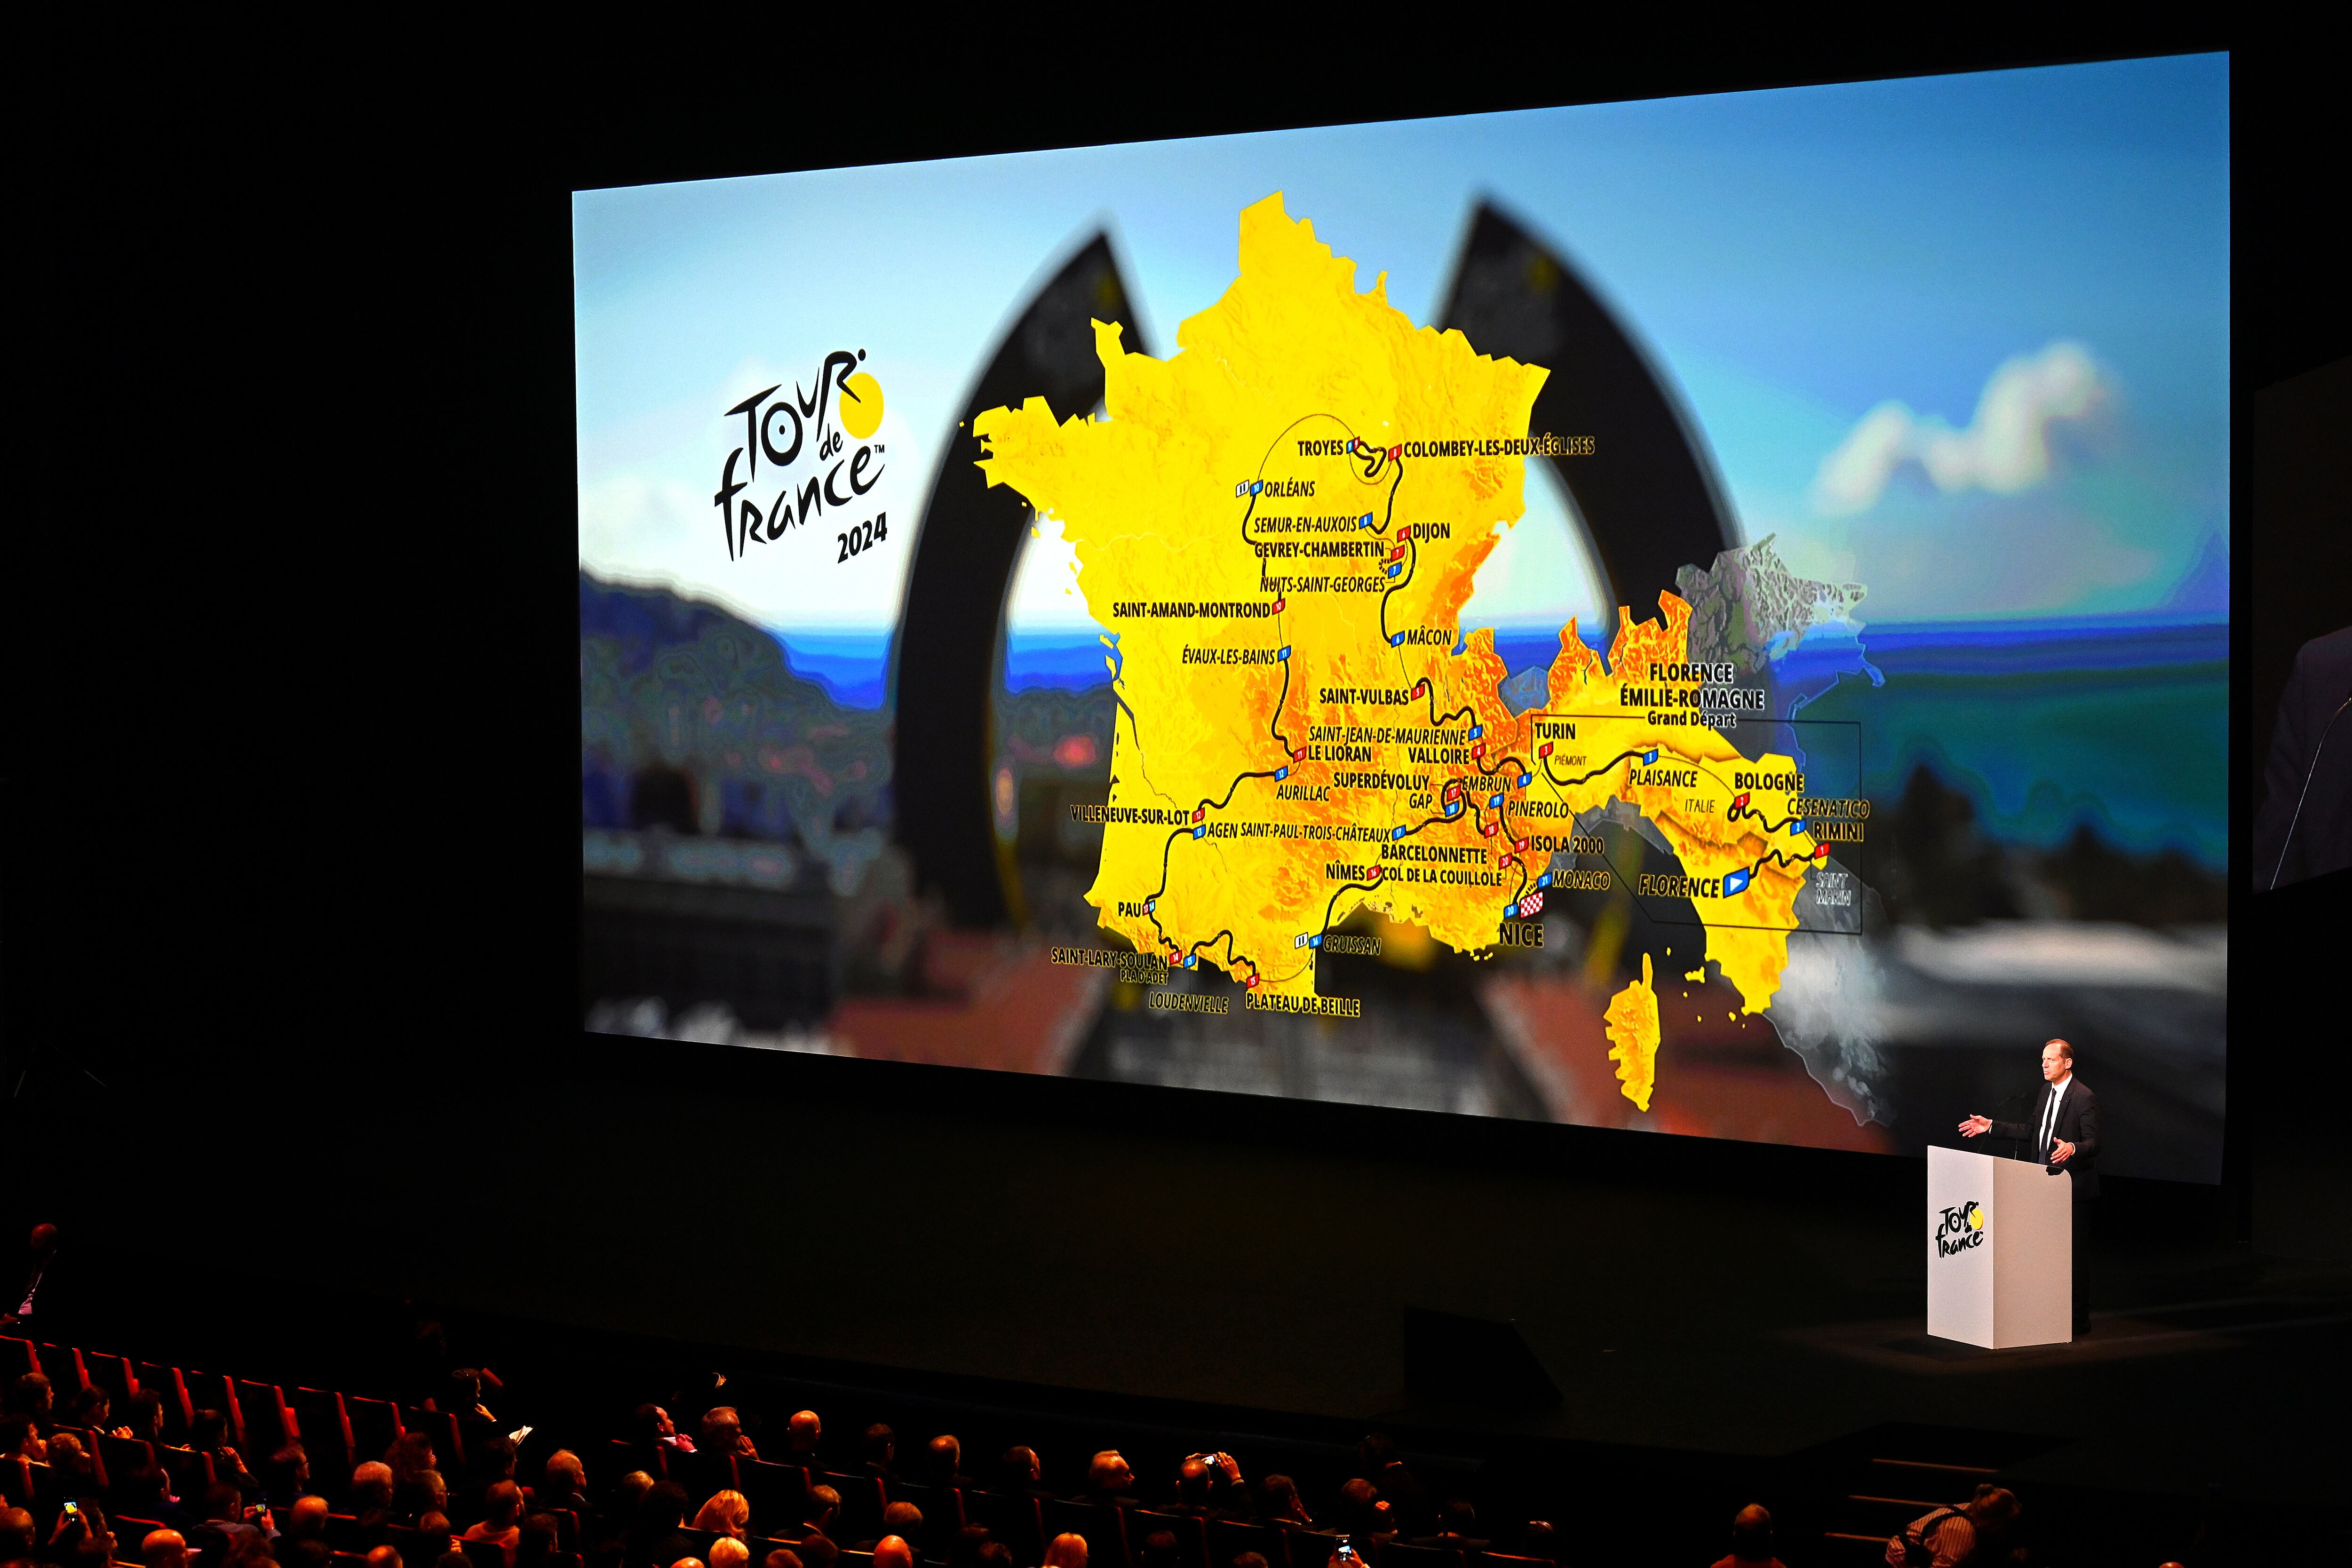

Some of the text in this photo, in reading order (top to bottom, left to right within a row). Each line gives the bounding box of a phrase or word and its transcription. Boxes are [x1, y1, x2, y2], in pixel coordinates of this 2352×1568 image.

[819, 423, 843, 461] de
[1297, 440, 1343, 456] TROYES
[1404, 432, 1596, 457] COLOMBEY-LES-DEUX-ÉGLISES
[1264, 477, 1315, 497] ORLÉANS
[1254, 515, 1358, 533] SEMUR-EN-AUXOIS
[1413, 523, 1450, 544] DIJON
[838, 512, 887, 564] 2024
[1255, 541, 1385, 558] GEVREY-CHAMBERTIN
[1260, 576, 1385, 593] NUITS-SAINT-GEORGES
[1112, 602, 1271, 618] SAINT-AMAND-MONTROND
[1407, 625, 1452, 646] MÂCON
[1182, 644, 1276, 665] ÉVAUX-LES-BAINS
[1650, 663, 1733, 683] FLORENCE
[1319, 688, 1409, 706] SAINT-VULBAS
[1620, 682, 1764, 710] ÉMILIE-ROMAGNE
[1647, 710, 1737, 731] Grand Départ
[1309, 726, 1466, 746] SAINT-JEAN-DE-MAURIENNE
[1534, 722, 1576, 740] TURIN
[1308, 744, 1371, 762] LE LIORAN
[1408, 747, 1470, 765] VALLOIRE
[1554, 753, 1587, 766] PIÉMONT
[1334, 769, 1430, 791] SUPERDÉVOLUY
[1462, 776, 1511, 792] EMBRUN
[1629, 768, 1698, 788] PLAISANCE
[1734, 771, 1804, 792] BOLOGNE
[1276, 784, 1331, 801] AURILLAC
[1409, 793, 1433, 809] GAP
[1070, 804, 1190, 826] VILLENEUVE-SUR-LOT
[1508, 800, 1569, 818] PINEROLO
[1685, 799, 1716, 813] ITALIE
[1788, 797, 1871, 819] CESENATICO
[1208, 822, 1239, 838] AGEN
[1240, 822, 1393, 843] SAINT-PAUL-TROIS-CHÂTEAUX
[1813, 820, 1864, 842] RIMINI
[1381, 844, 1487, 864] BARCELONNETTE
[1532, 835, 1605, 854] ISOLA 2000
[1326, 859, 1365, 881] NÎMES
[1382, 866, 1502, 887] COL DE LA COUILLOLE
[1552, 869, 1611, 890] MONACO
[1638, 874, 1720, 898] FLORENCE
[1118, 902, 1141, 918] PAU
[1323, 934, 1382, 956] GRUISSAN
[1499, 923, 1544, 948] NICE
[1051, 947, 1168, 971] SAINT-LARY-SOULAN
[1120, 969, 1137, 982] PLA
[1148, 991, 1229, 1014] LOUDENVIELLE
[1246, 992, 1361, 1018] PLATEAU DE BEILLE
